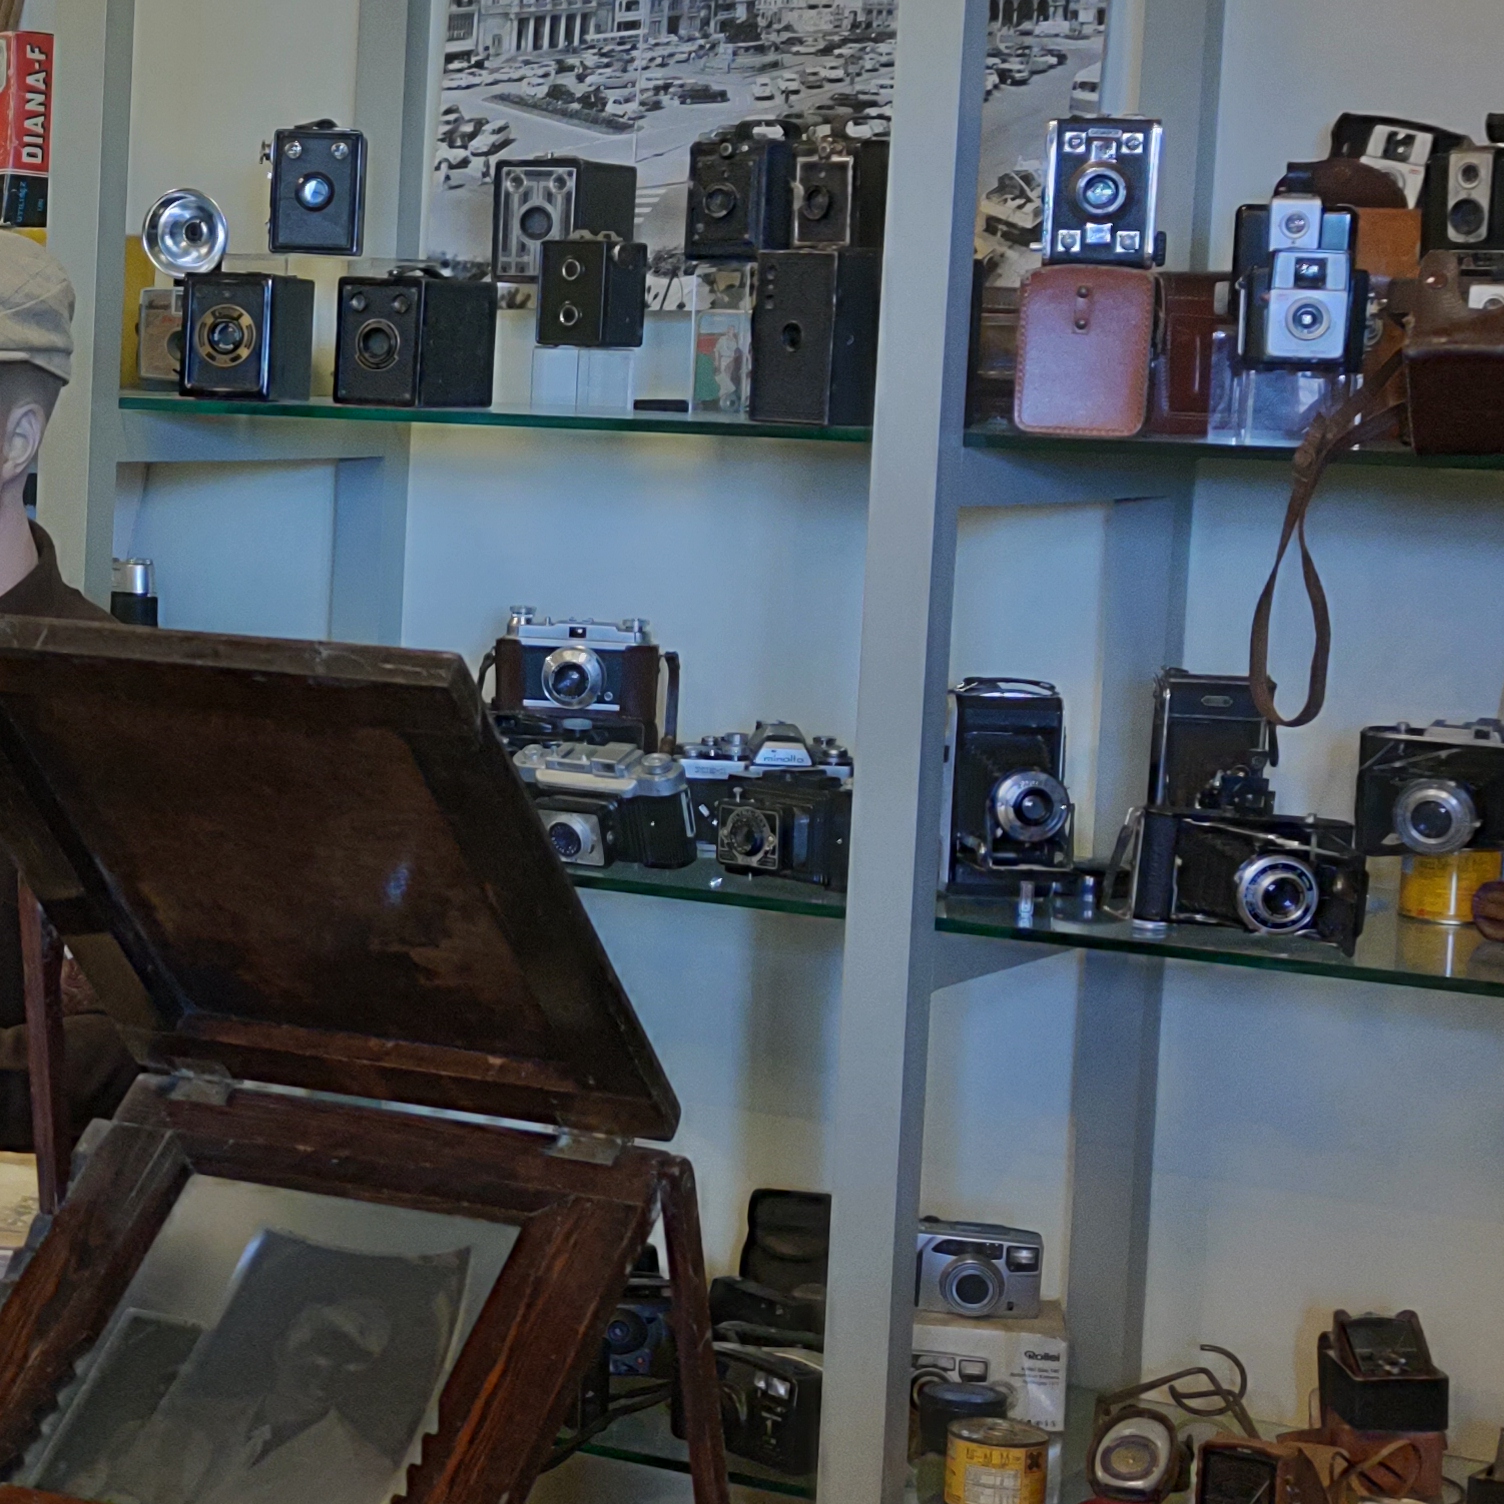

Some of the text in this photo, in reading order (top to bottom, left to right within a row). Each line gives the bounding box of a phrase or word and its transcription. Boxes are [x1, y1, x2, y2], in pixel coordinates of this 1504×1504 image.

[21, 42, 49, 165] DIANA-F
[763, 749, 805, 764] minolta
[1024, 1350, 1061, 1363] Rollei
